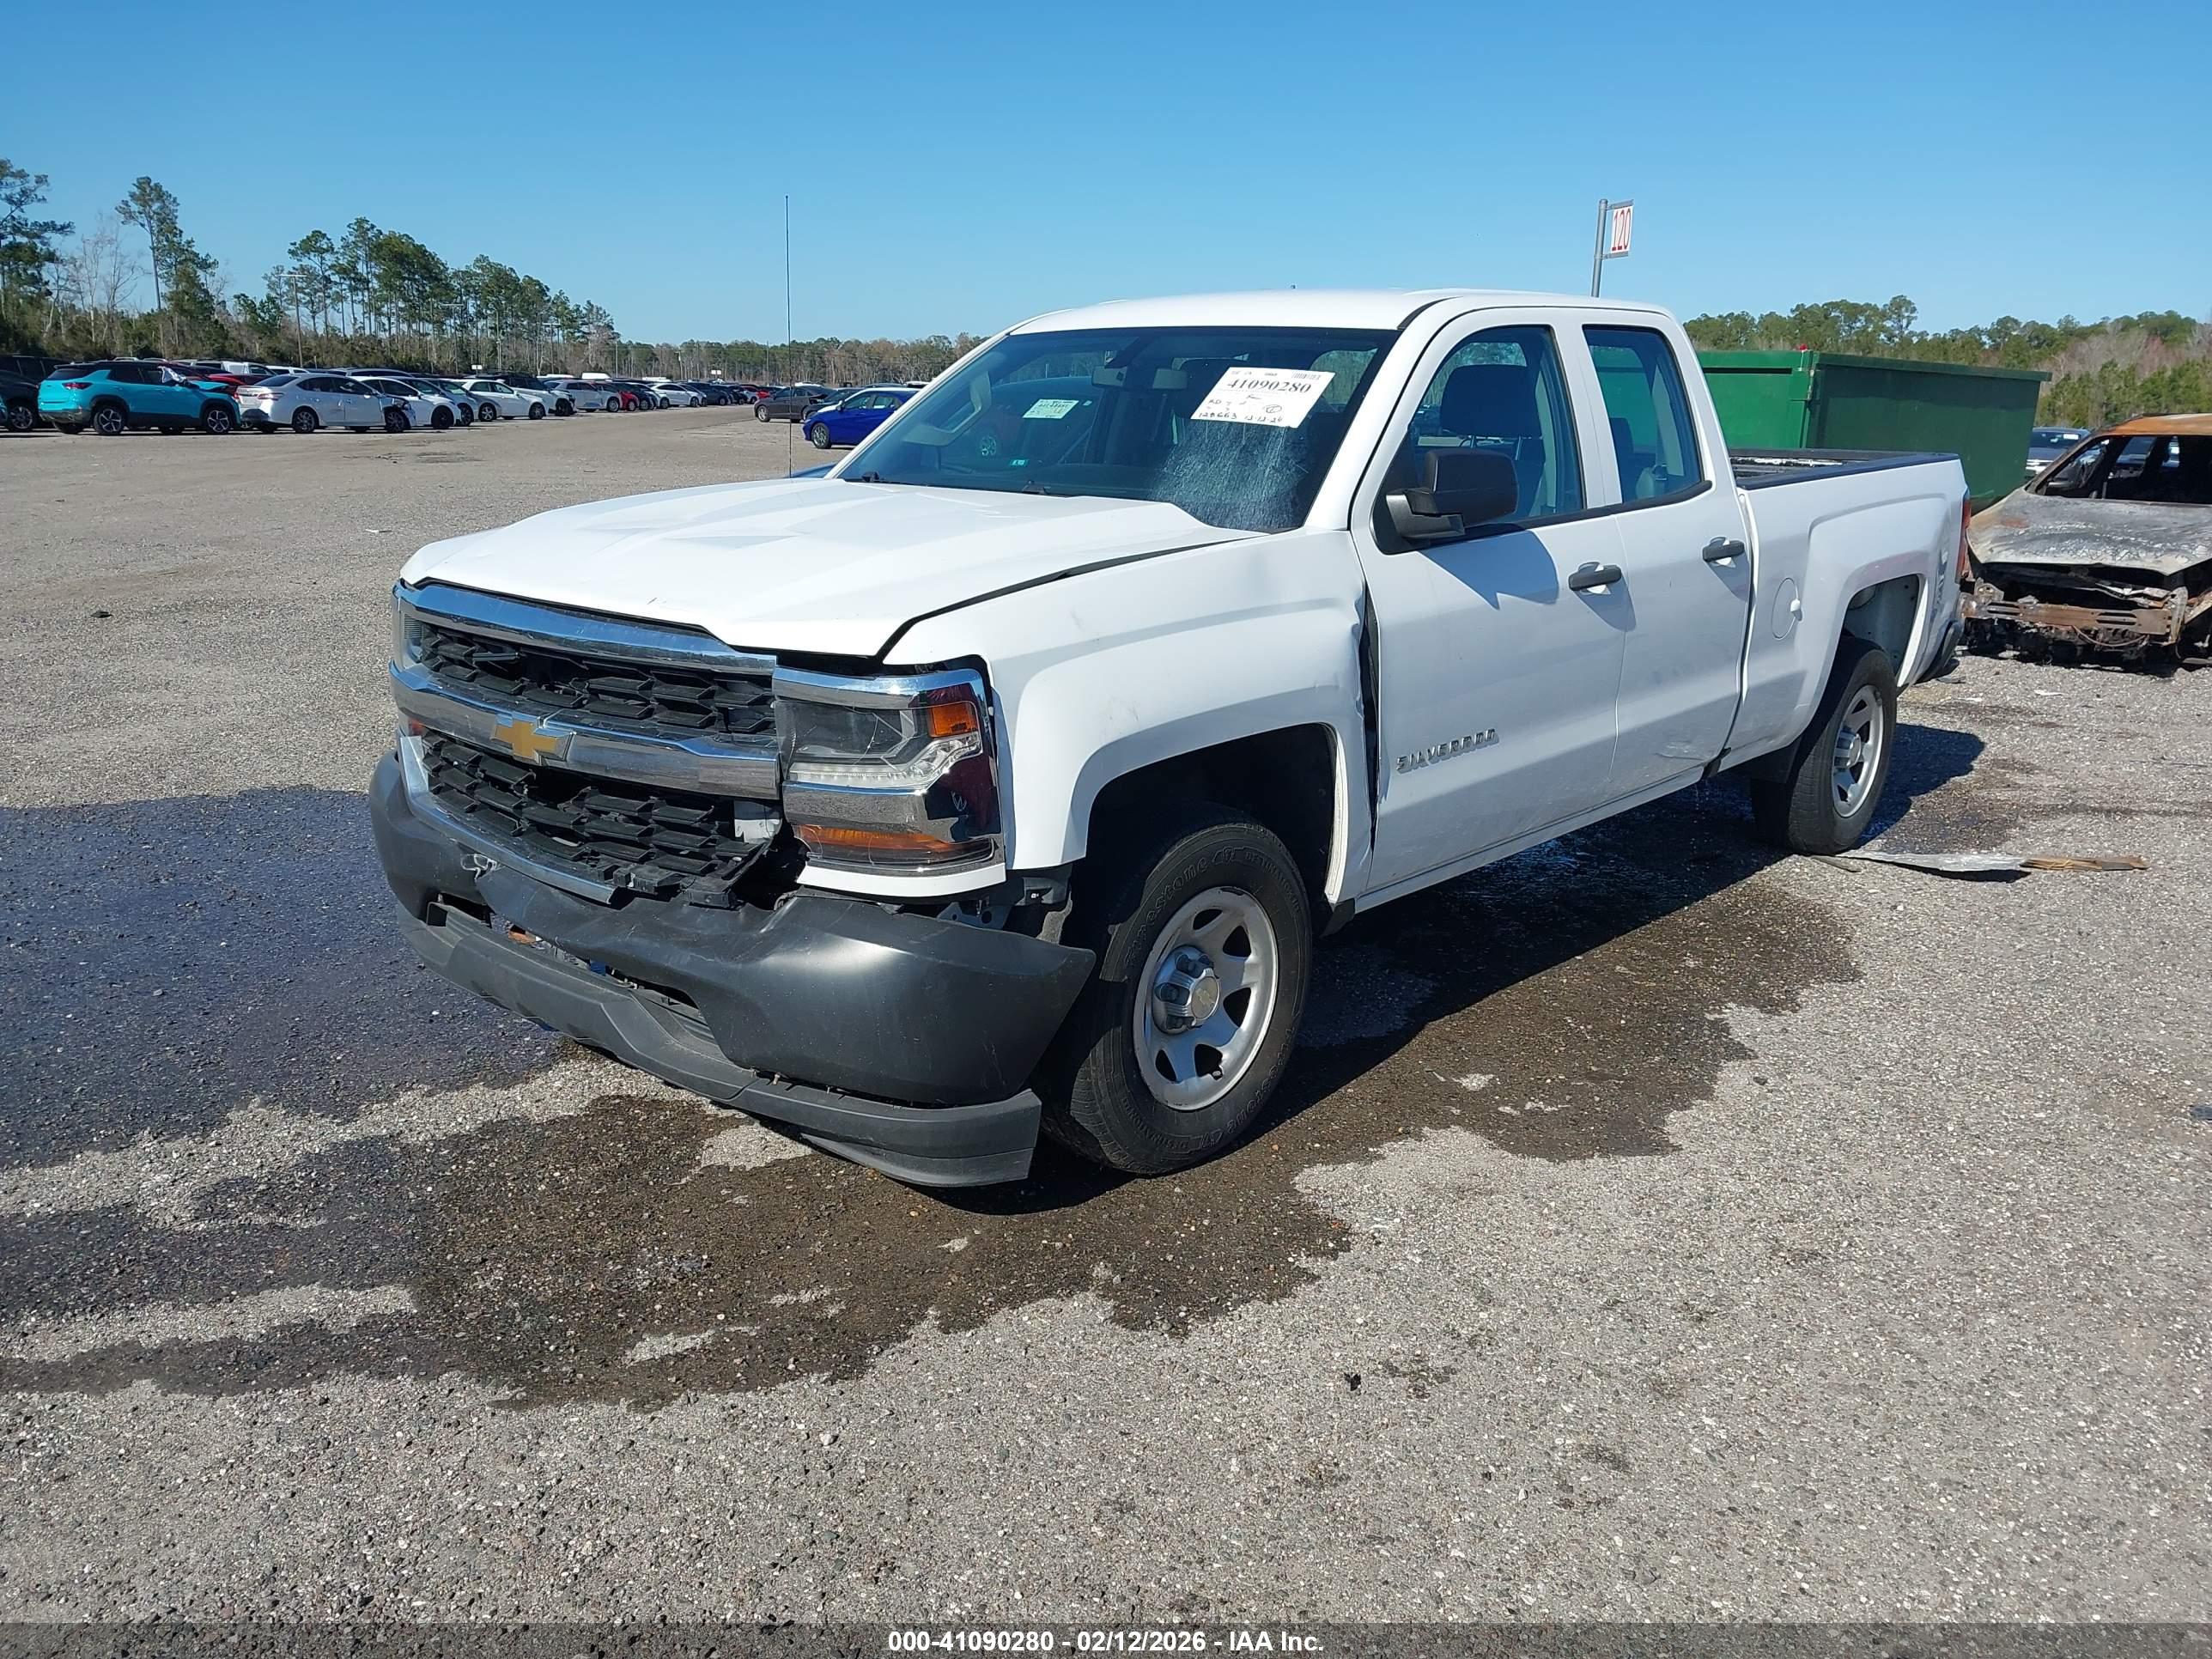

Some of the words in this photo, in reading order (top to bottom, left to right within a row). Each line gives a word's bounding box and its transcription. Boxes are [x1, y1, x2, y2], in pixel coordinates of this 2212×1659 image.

[1612, 208, 1632, 252] 120
[1227, 378, 1312, 393] 41090280
[1395, 727, 1498, 773] SILVERADO
